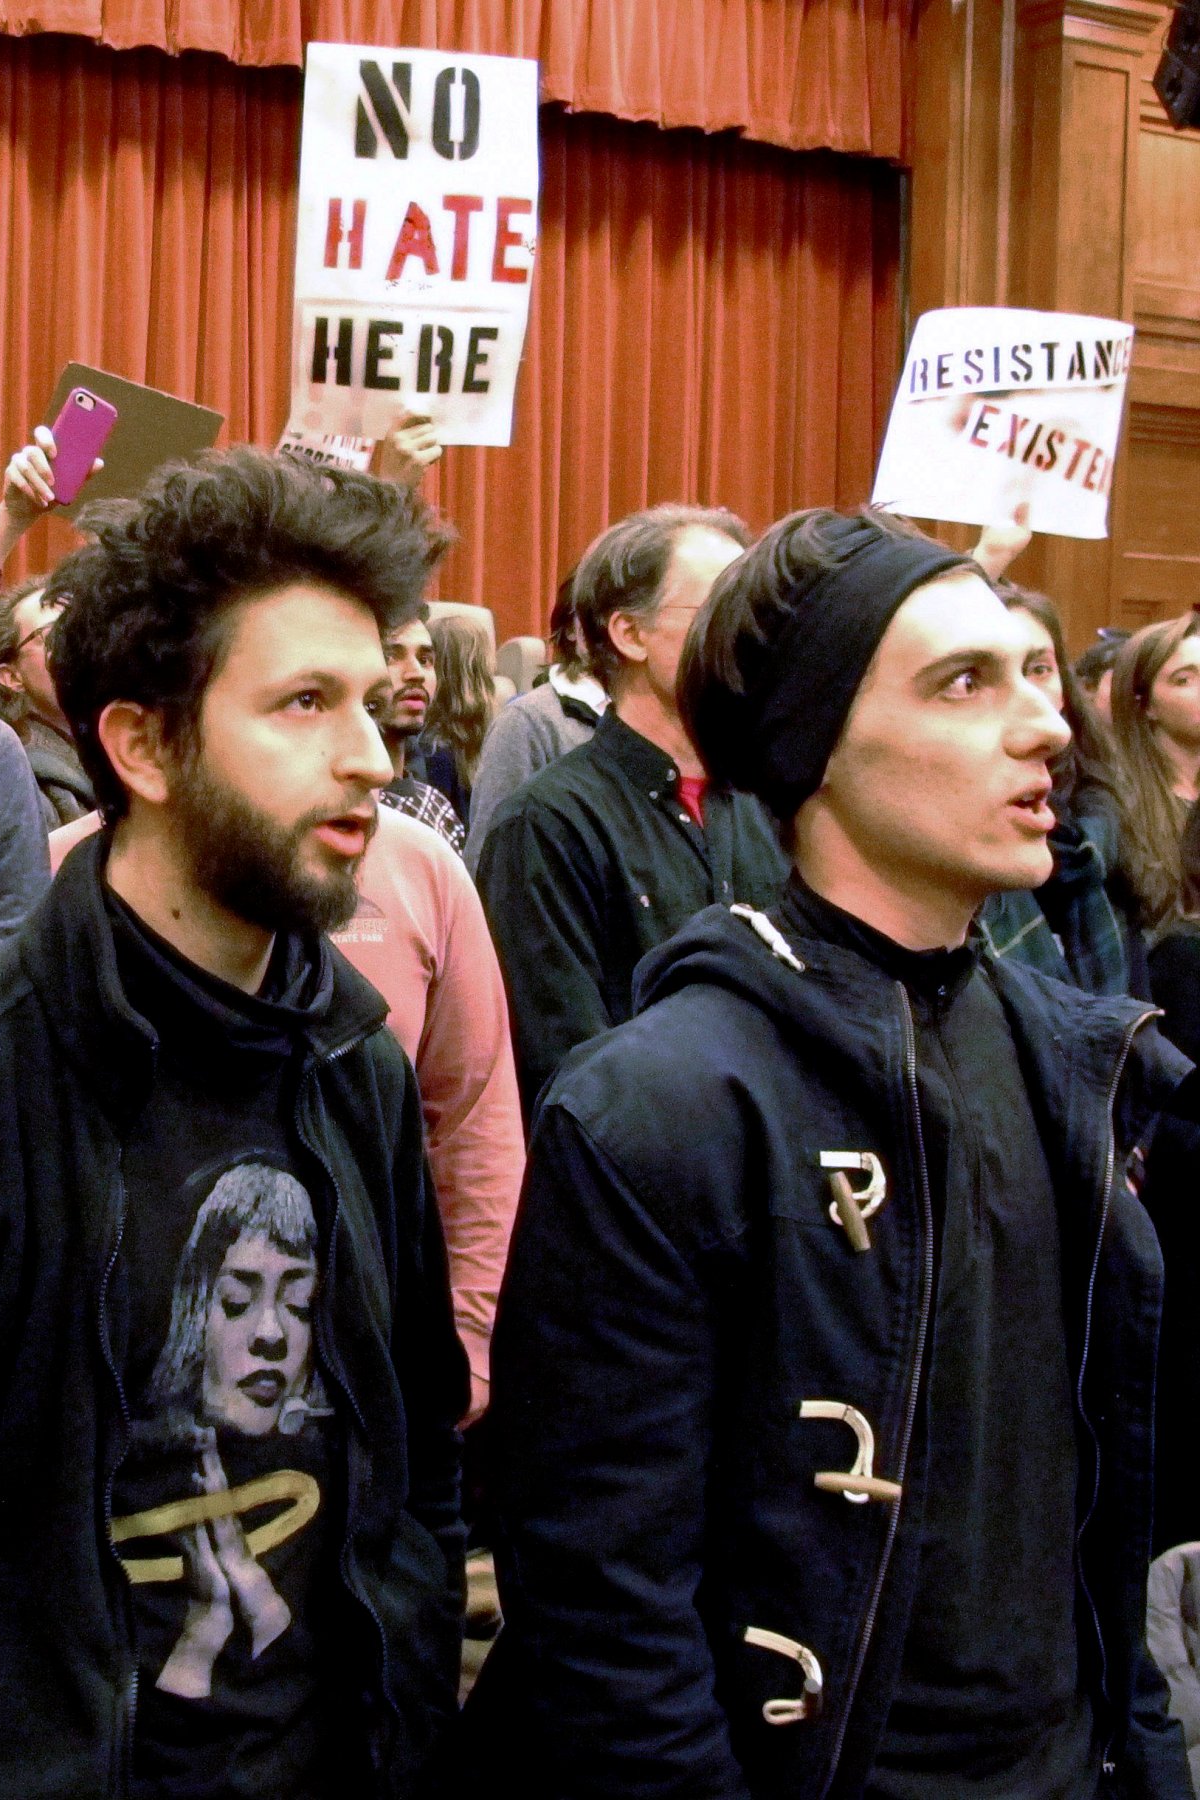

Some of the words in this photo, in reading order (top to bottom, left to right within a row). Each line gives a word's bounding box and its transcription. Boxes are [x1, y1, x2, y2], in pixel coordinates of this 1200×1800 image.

[354, 59, 480, 161] NO
[323, 194, 534, 284] HATE
[311, 316, 499, 394] HERE
